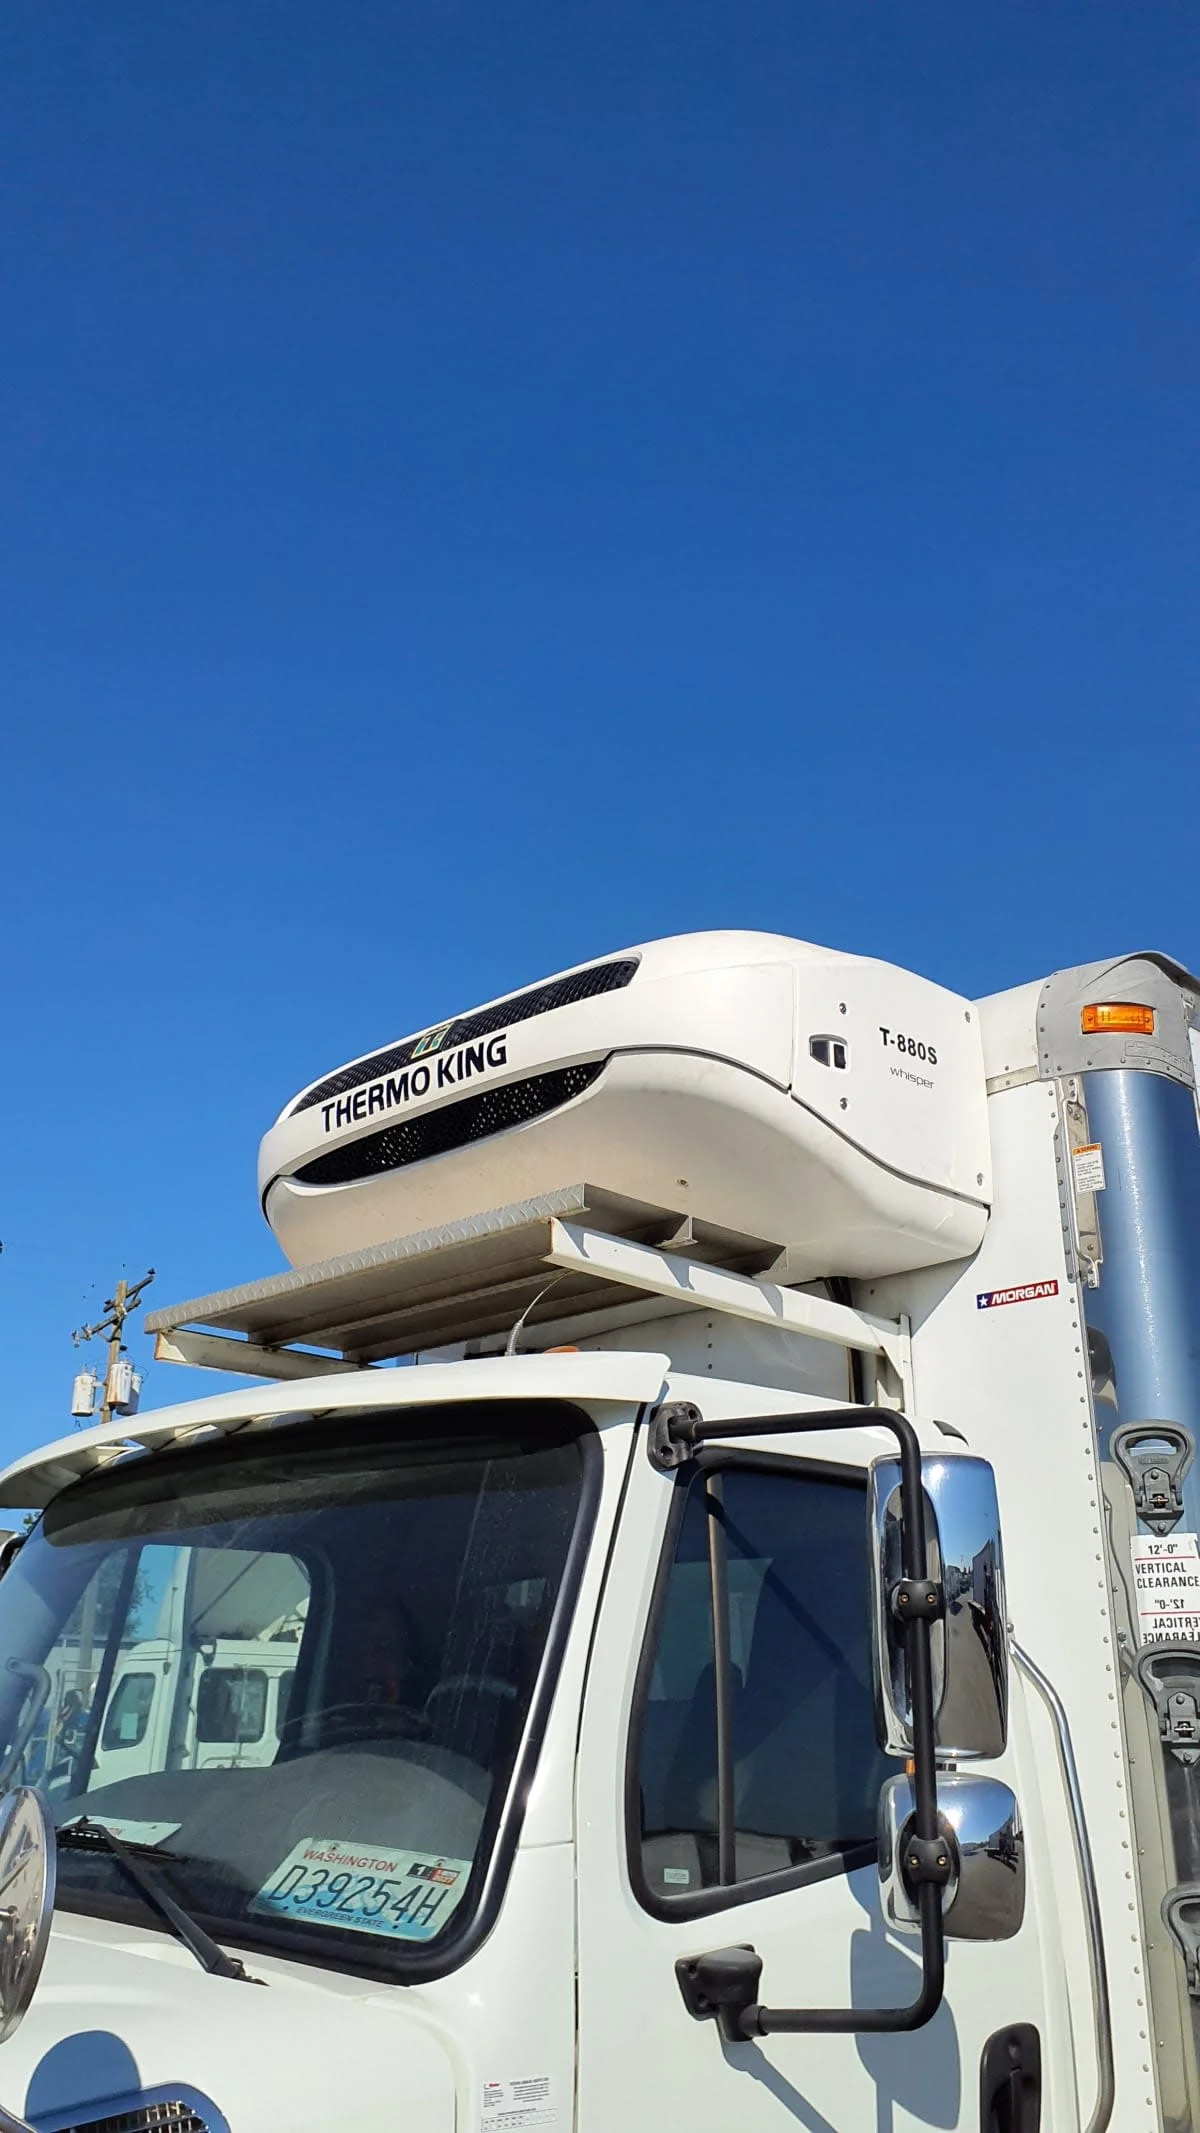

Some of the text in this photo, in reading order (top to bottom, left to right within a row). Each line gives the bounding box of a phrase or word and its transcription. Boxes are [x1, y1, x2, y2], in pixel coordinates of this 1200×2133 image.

[879, 1026, 938, 1065] T-880S
[322, 1034, 508, 1132] THERMO KING
[889, 1066, 934, 1089] whisper
[991, 1282, 1056, 1305] MORGAN
[1148, 1543, 1178, 1555] 12'-0"
[1135, 1562, 1187, 1574] VERTICAL
[1136, 1576, 1200, 1589] CLEARANCE
[303, 1848, 398, 1873] WASHINGTON
[268, 1864, 449, 1927] D39254H
[296, 1906, 385, 1928] EVERGREEN STATE
